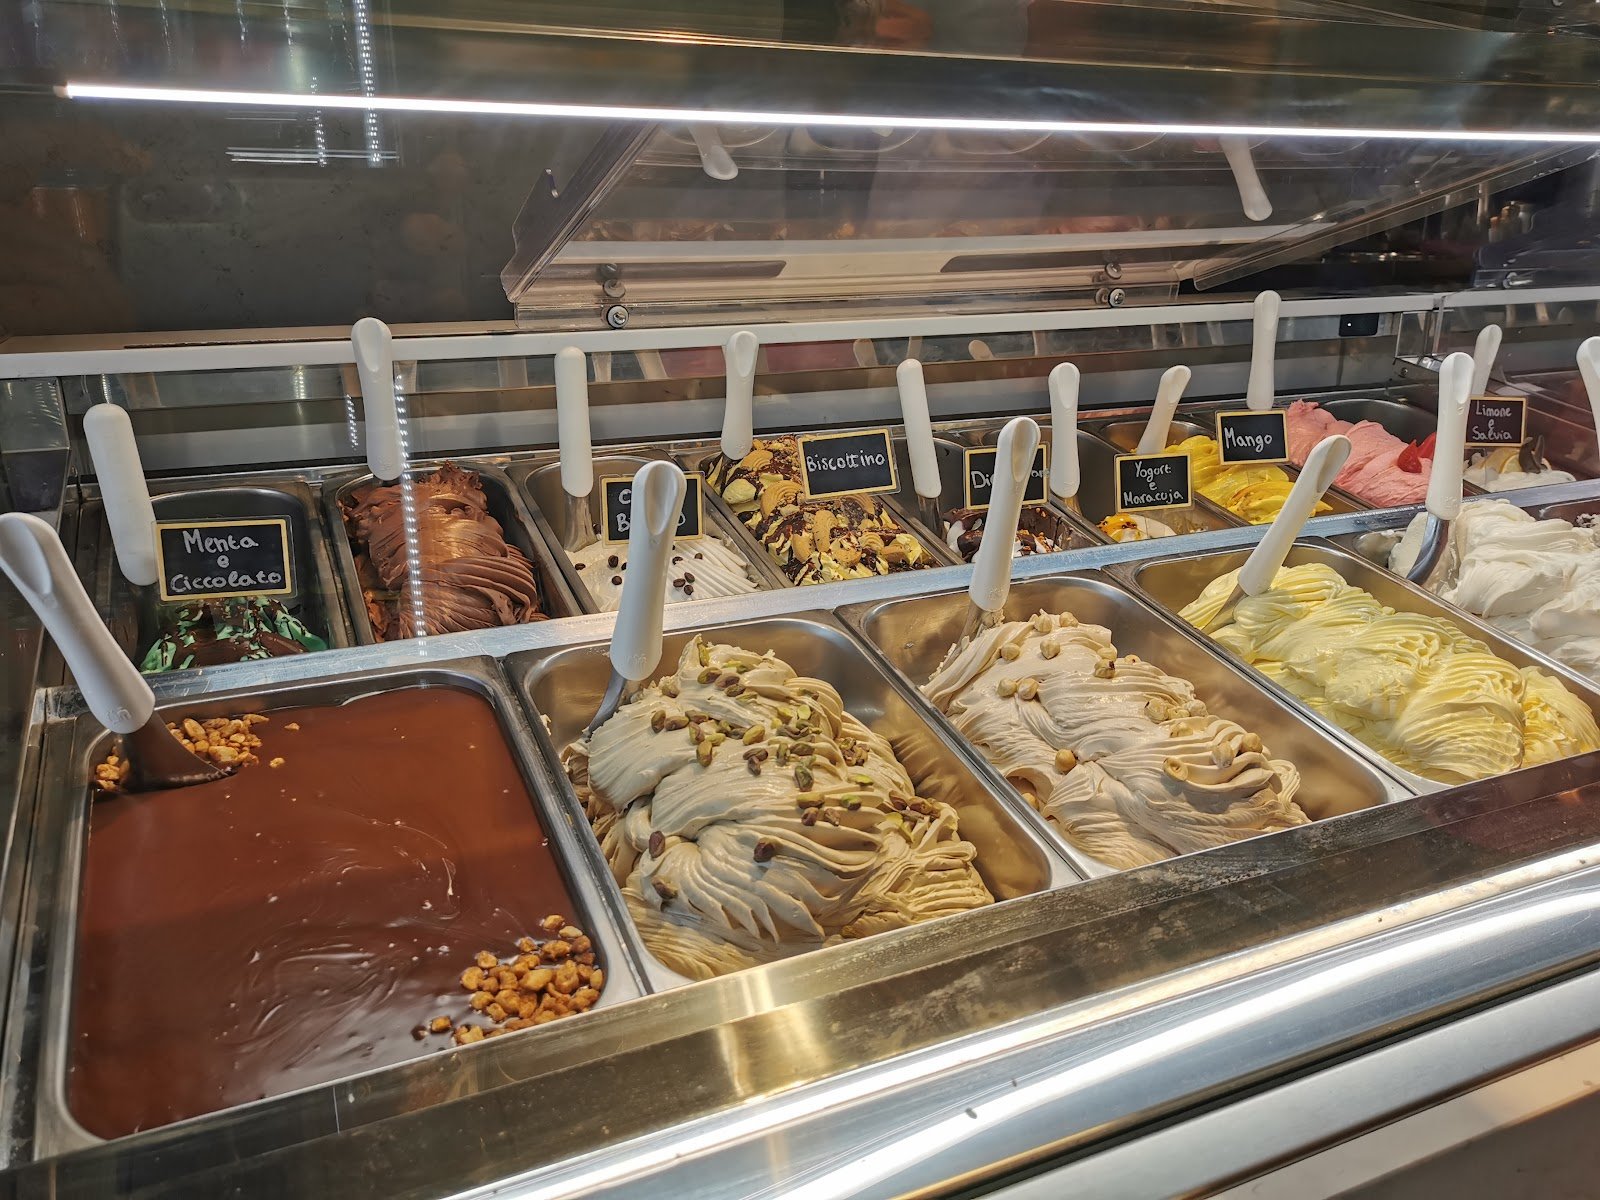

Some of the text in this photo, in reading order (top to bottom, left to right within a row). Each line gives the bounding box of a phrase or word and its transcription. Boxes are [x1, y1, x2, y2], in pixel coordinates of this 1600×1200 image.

[1475, 400, 1512, 417] Limone
[1472, 425, 1512, 440] Salvia
[1487, 419, 1495, 429] e
[1224, 427, 1273, 453] Mango
[806, 450, 886, 472] Biscottino
[1134, 461, 1171, 483] Yogurt
[1149, 481, 1157, 490] e
[1123, 489, 1184, 506] Maracuja
[182, 528, 259, 554] Menta
[216, 554, 230, 568] e
[170, 570, 282, 593] Ciccolato
